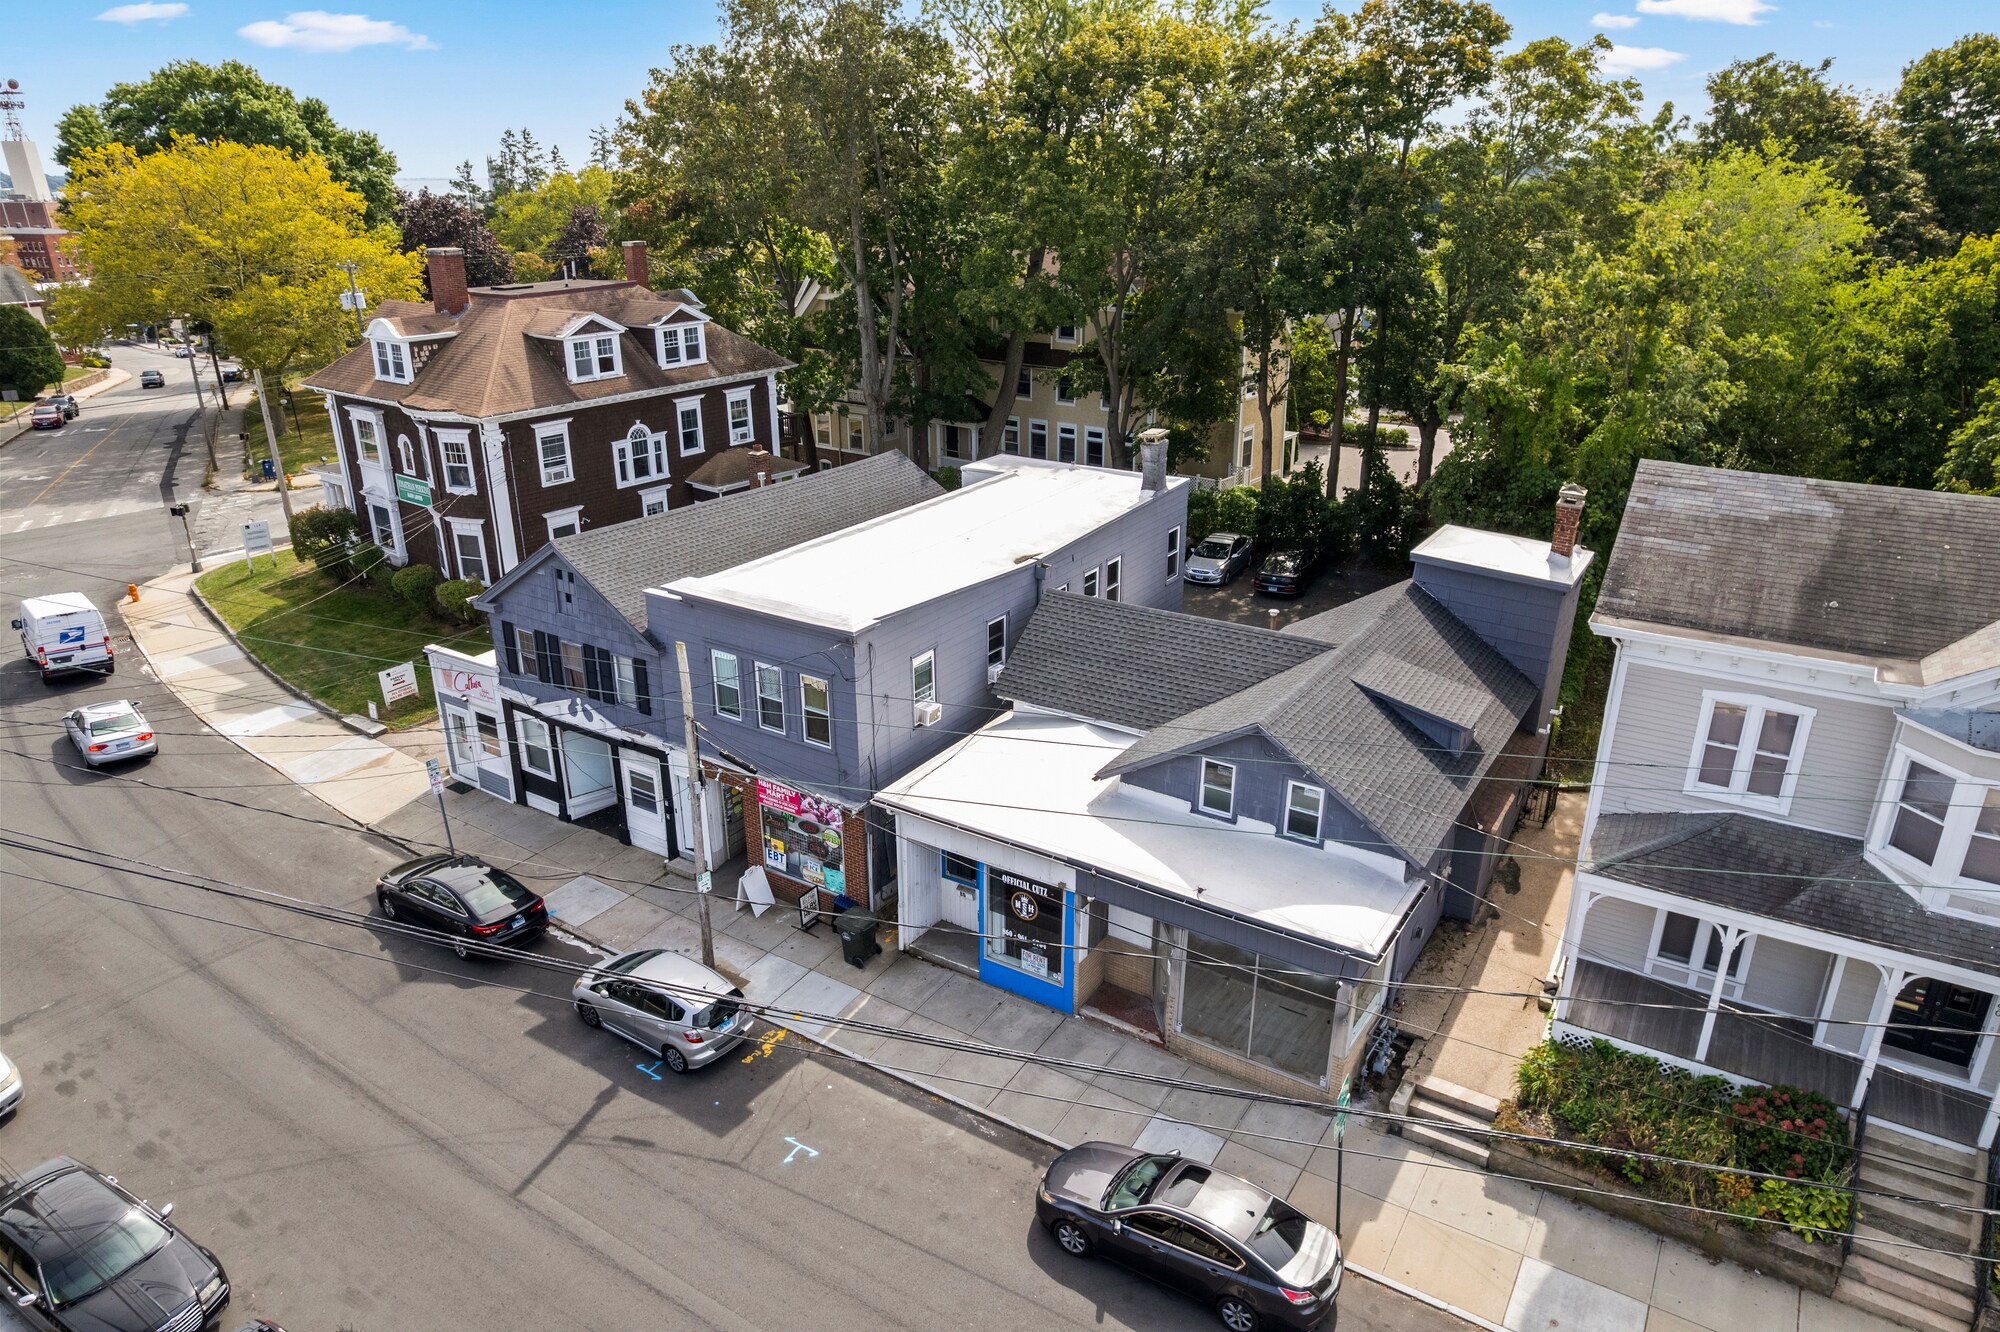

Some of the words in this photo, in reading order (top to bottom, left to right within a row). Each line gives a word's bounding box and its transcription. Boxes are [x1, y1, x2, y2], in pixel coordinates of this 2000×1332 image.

[766, 788, 785, 800] MART
[772, 784, 796, 798] FAMILY
[782, 811, 794, 821] ATM
[767, 848, 785, 863] EBT
[809, 864, 818, 872] ICE
[1002, 874, 1031, 891] OFFICIAL
[1031, 884, 1048, 897] CUTZ
